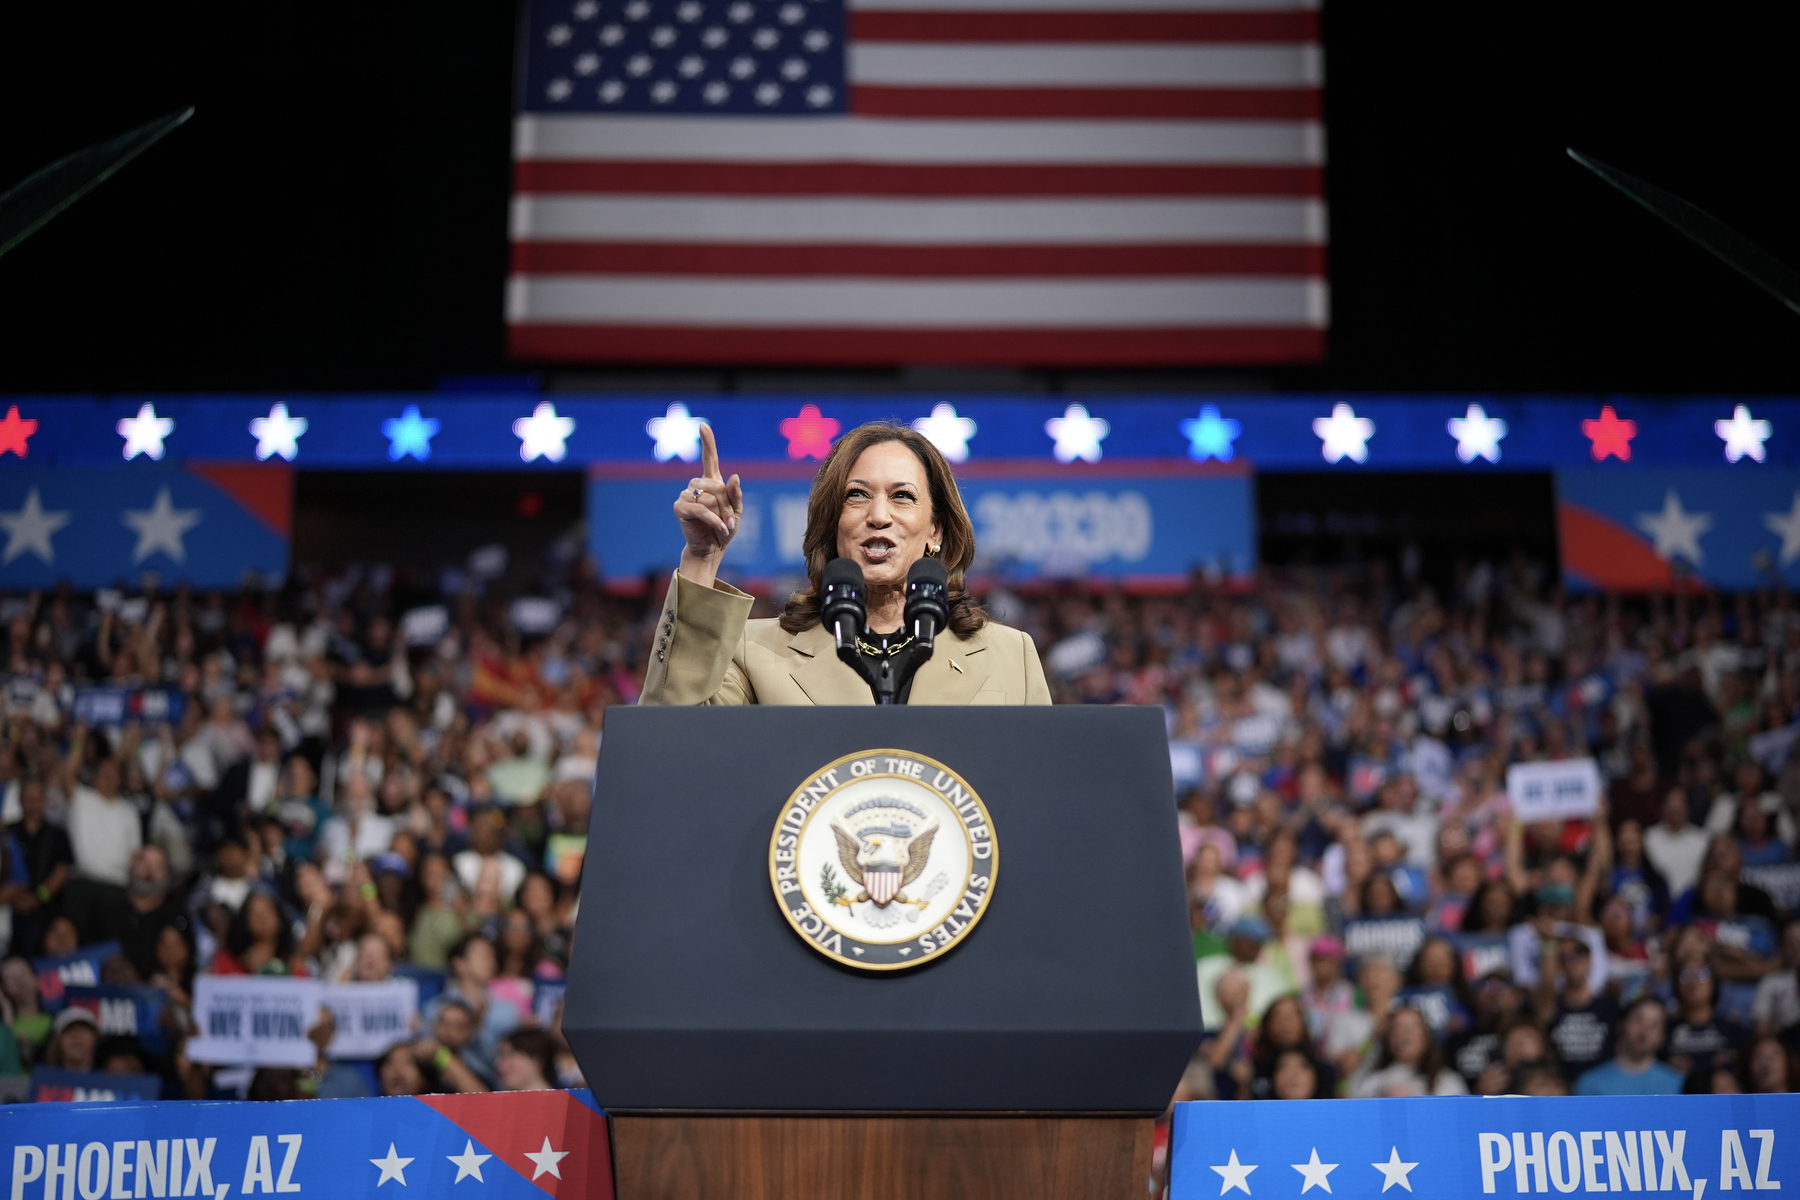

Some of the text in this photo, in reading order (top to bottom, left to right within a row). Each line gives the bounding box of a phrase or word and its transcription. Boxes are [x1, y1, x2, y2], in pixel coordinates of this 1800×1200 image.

[776, 758, 992, 955] VICE PRESIDENT OF THE UNITED STATES
[209, 1011, 303, 1038] WE WIN
[11, 1134, 303, 1200] PHOENIX, AZ
[1478, 1129, 1782, 1200] PHOENIX, AZ
